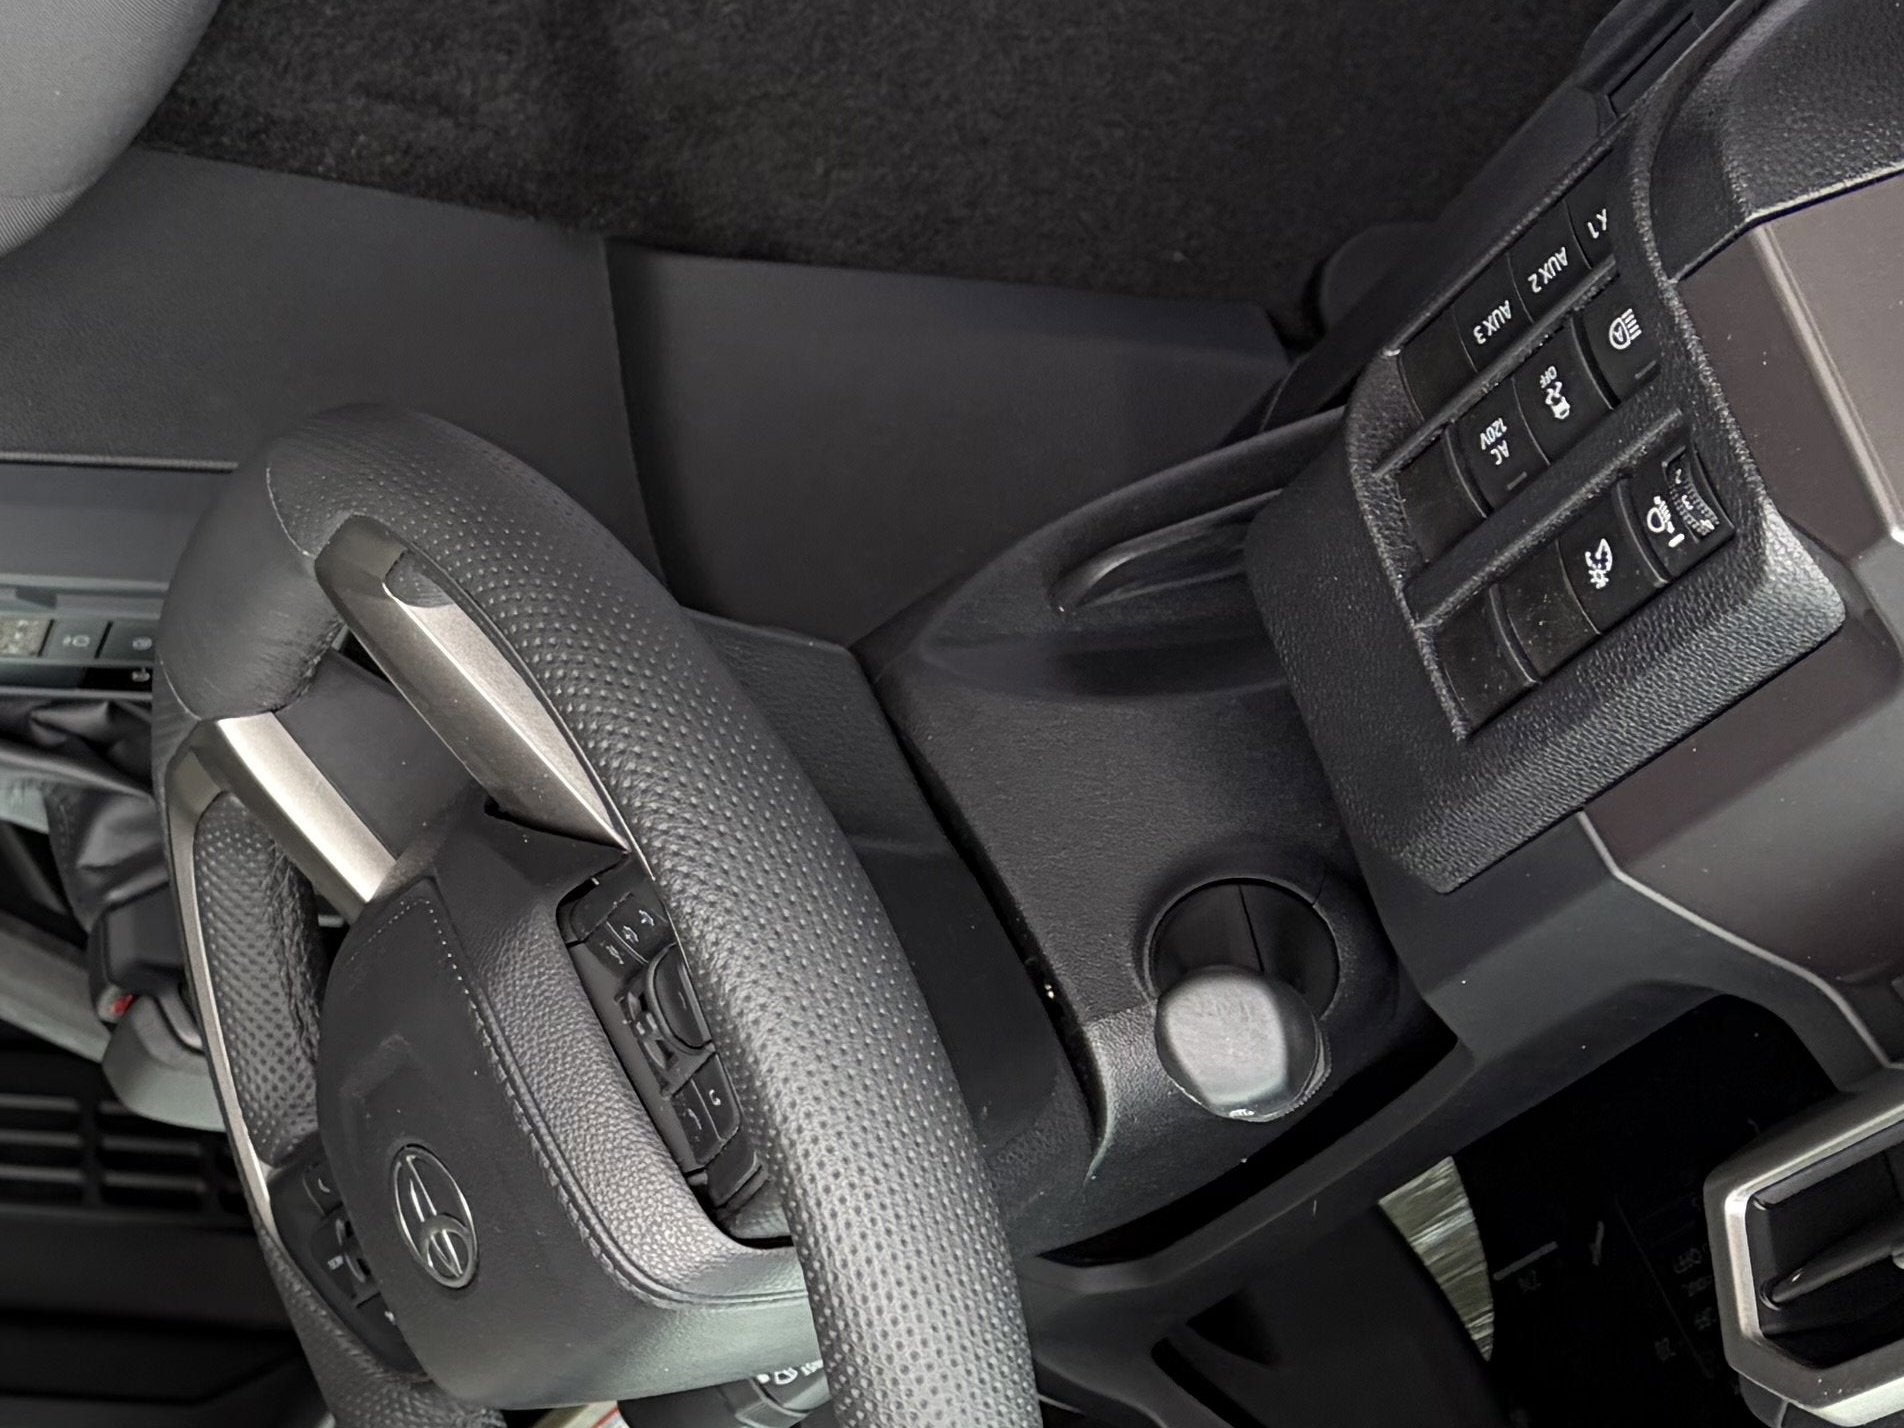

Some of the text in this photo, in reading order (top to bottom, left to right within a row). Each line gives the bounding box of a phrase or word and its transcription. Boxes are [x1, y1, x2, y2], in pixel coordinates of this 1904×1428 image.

[1527, 246, 1569, 293] AUX 2
[1473, 299, 1512, 345] AUX 3
[1539, 365, 1558, 389] OFF
[1479, 417, 1509, 450] 120V
[1490, 439, 1510, 465] AC
